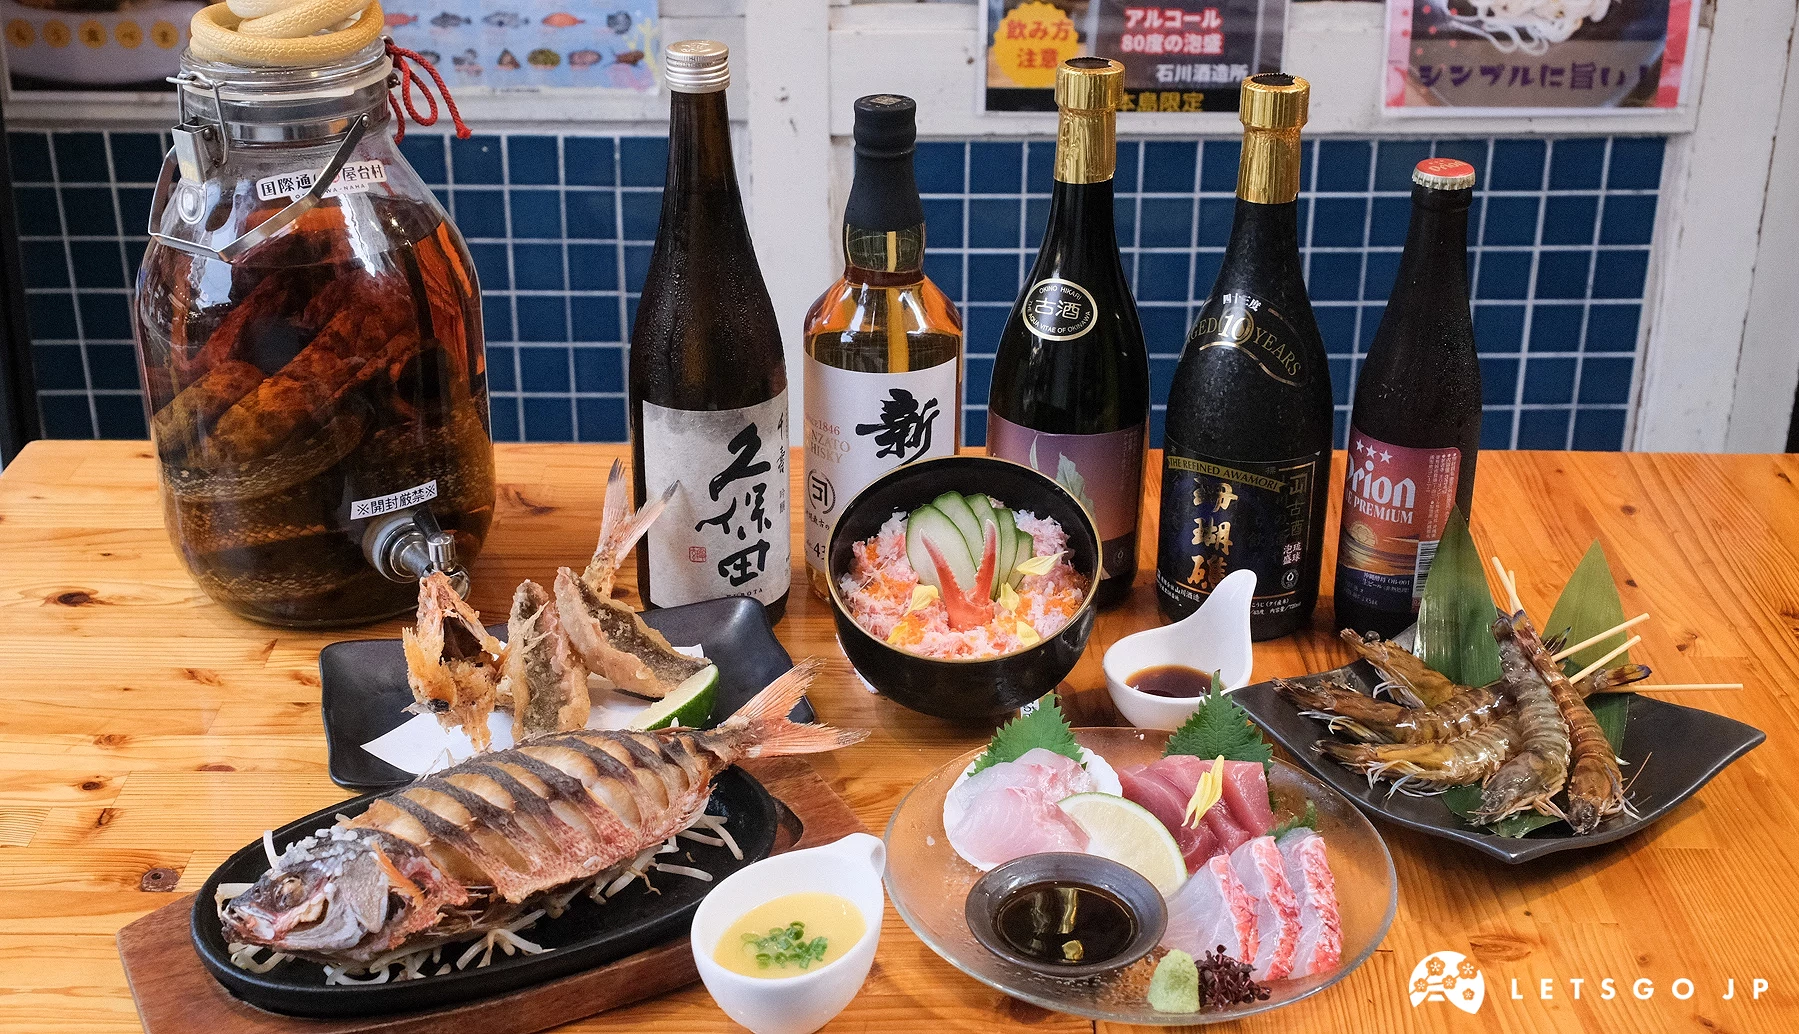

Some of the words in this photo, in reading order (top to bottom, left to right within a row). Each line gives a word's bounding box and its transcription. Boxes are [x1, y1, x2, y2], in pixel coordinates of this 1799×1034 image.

[1006, 19, 1073, 41] 飲み方
[1123, 8, 1223, 29] アルコール
[1120, 33, 1225, 54] 80度の泡盛
[1016, 48, 1058, 69] 注意
[1155, 63, 1249, 83] 石川酒造所
[260, 164, 384, 197] 国際通屋台村
[1060, 286, 1083, 301] HIKARI
[1034, 297, 1083, 320] 古酒
[1067, 310, 1092, 333] OKINAWA
[1217, 313, 1251, 341] 10
[1252, 326, 1302, 376] YEARS
[855, 388, 940, 464] 新
[809, 441, 843, 464] HISKY
[1169, 457, 1181, 468] THE
[1182, 460, 1221, 476] REFINED
[1222, 469, 1279, 491] AWAMORI
[695, 421, 772, 587] 久保田
[1353, 496, 1414, 525] PREMIUM
